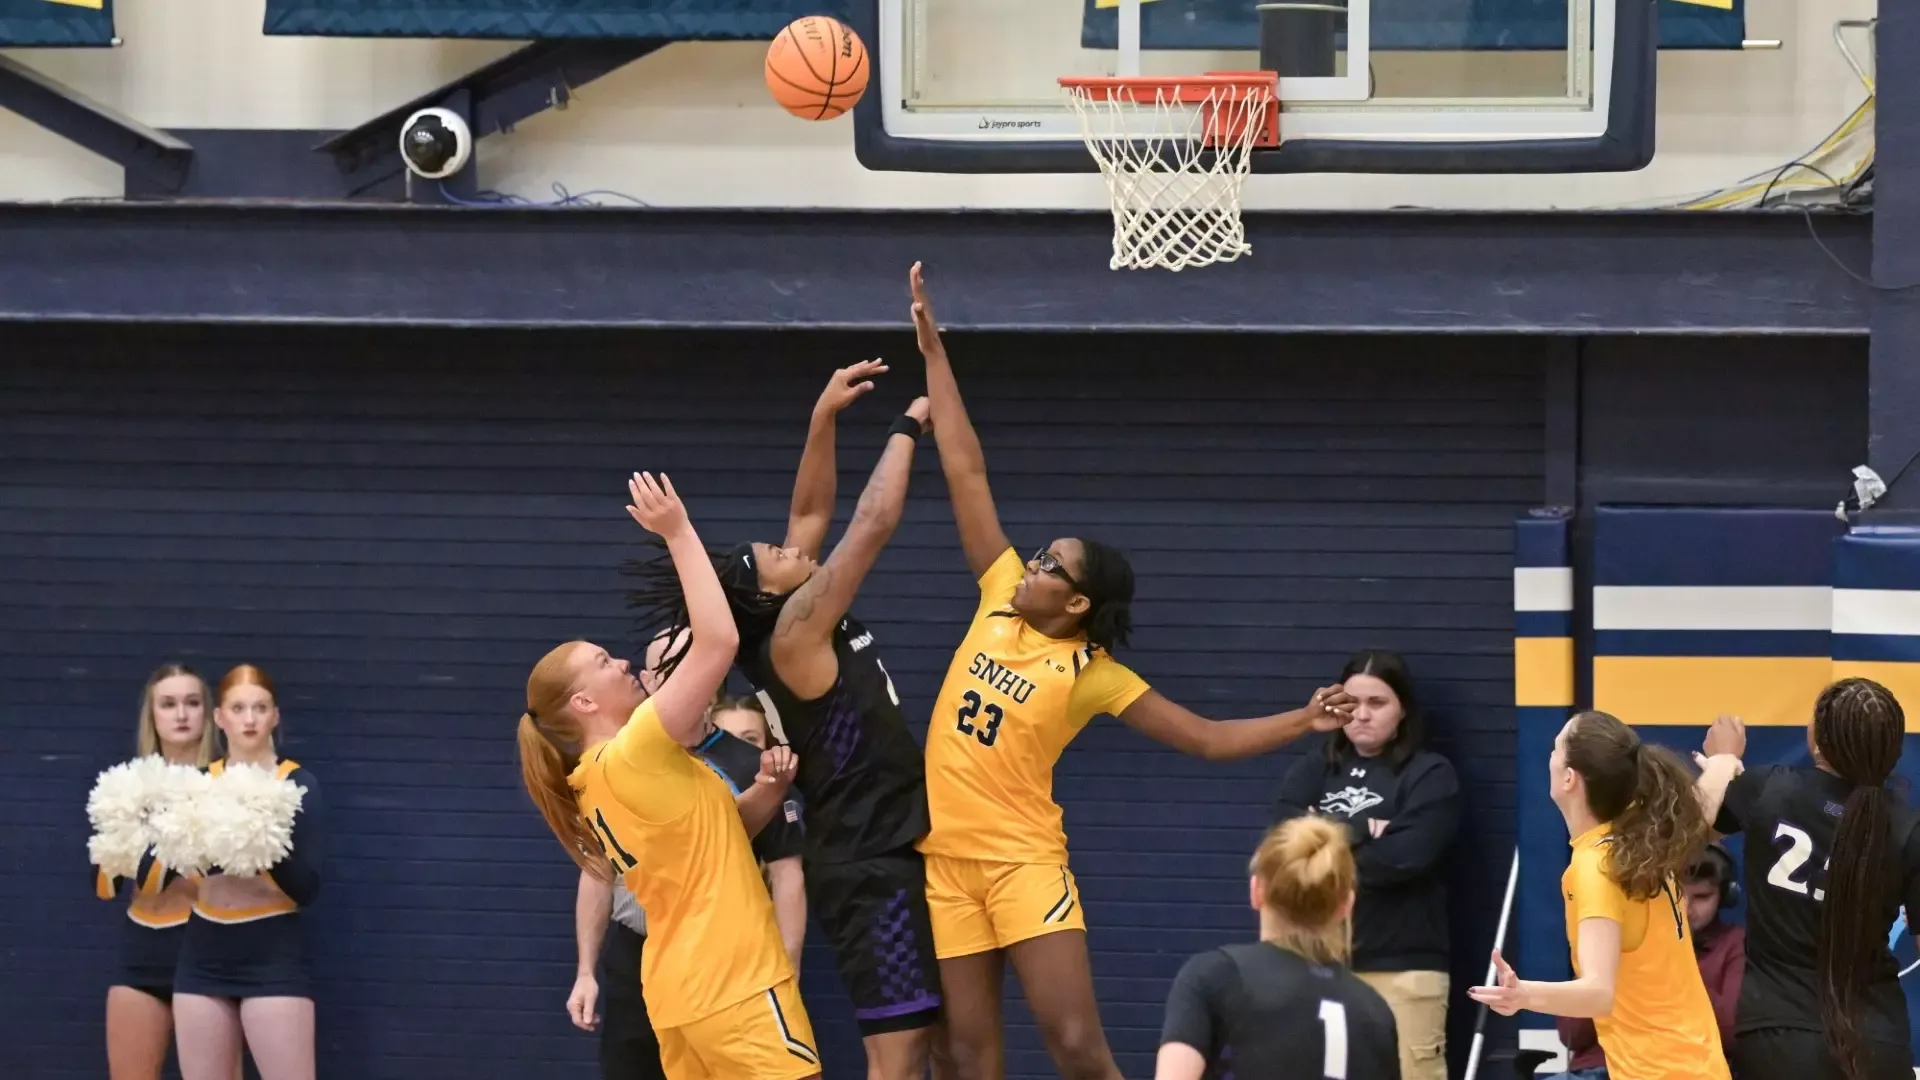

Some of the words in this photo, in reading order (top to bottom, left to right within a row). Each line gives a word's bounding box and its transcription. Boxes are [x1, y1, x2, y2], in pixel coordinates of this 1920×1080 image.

[991, 119, 1016, 130] jaypro
[1017, 120, 1042, 129] sports
[968, 652, 1036, 704] SNHU
[956, 689, 1004, 747] 23
[1767, 822, 1829, 901] 2
[1318, 998, 1347, 1080] 1
